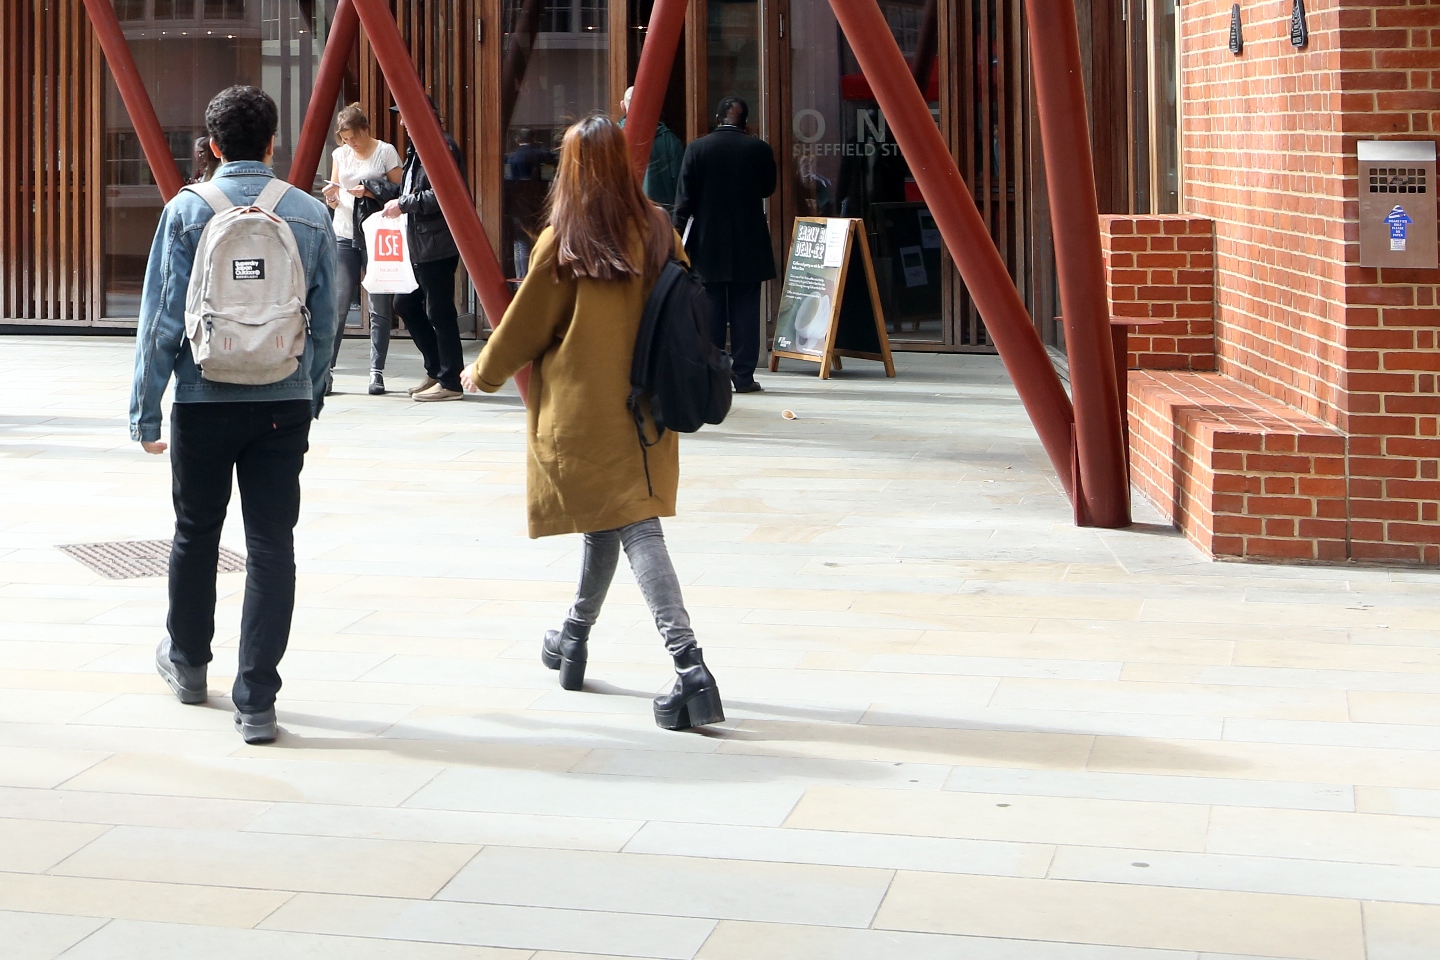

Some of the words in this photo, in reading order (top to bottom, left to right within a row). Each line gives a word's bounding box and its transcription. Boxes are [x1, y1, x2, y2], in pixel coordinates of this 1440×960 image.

[792, 143, 876, 157] SHEFFIELD
[881, 143, 904, 157] ST
[797, 224, 820, 242] EARLY
[378, 234, 399, 257] LSE
